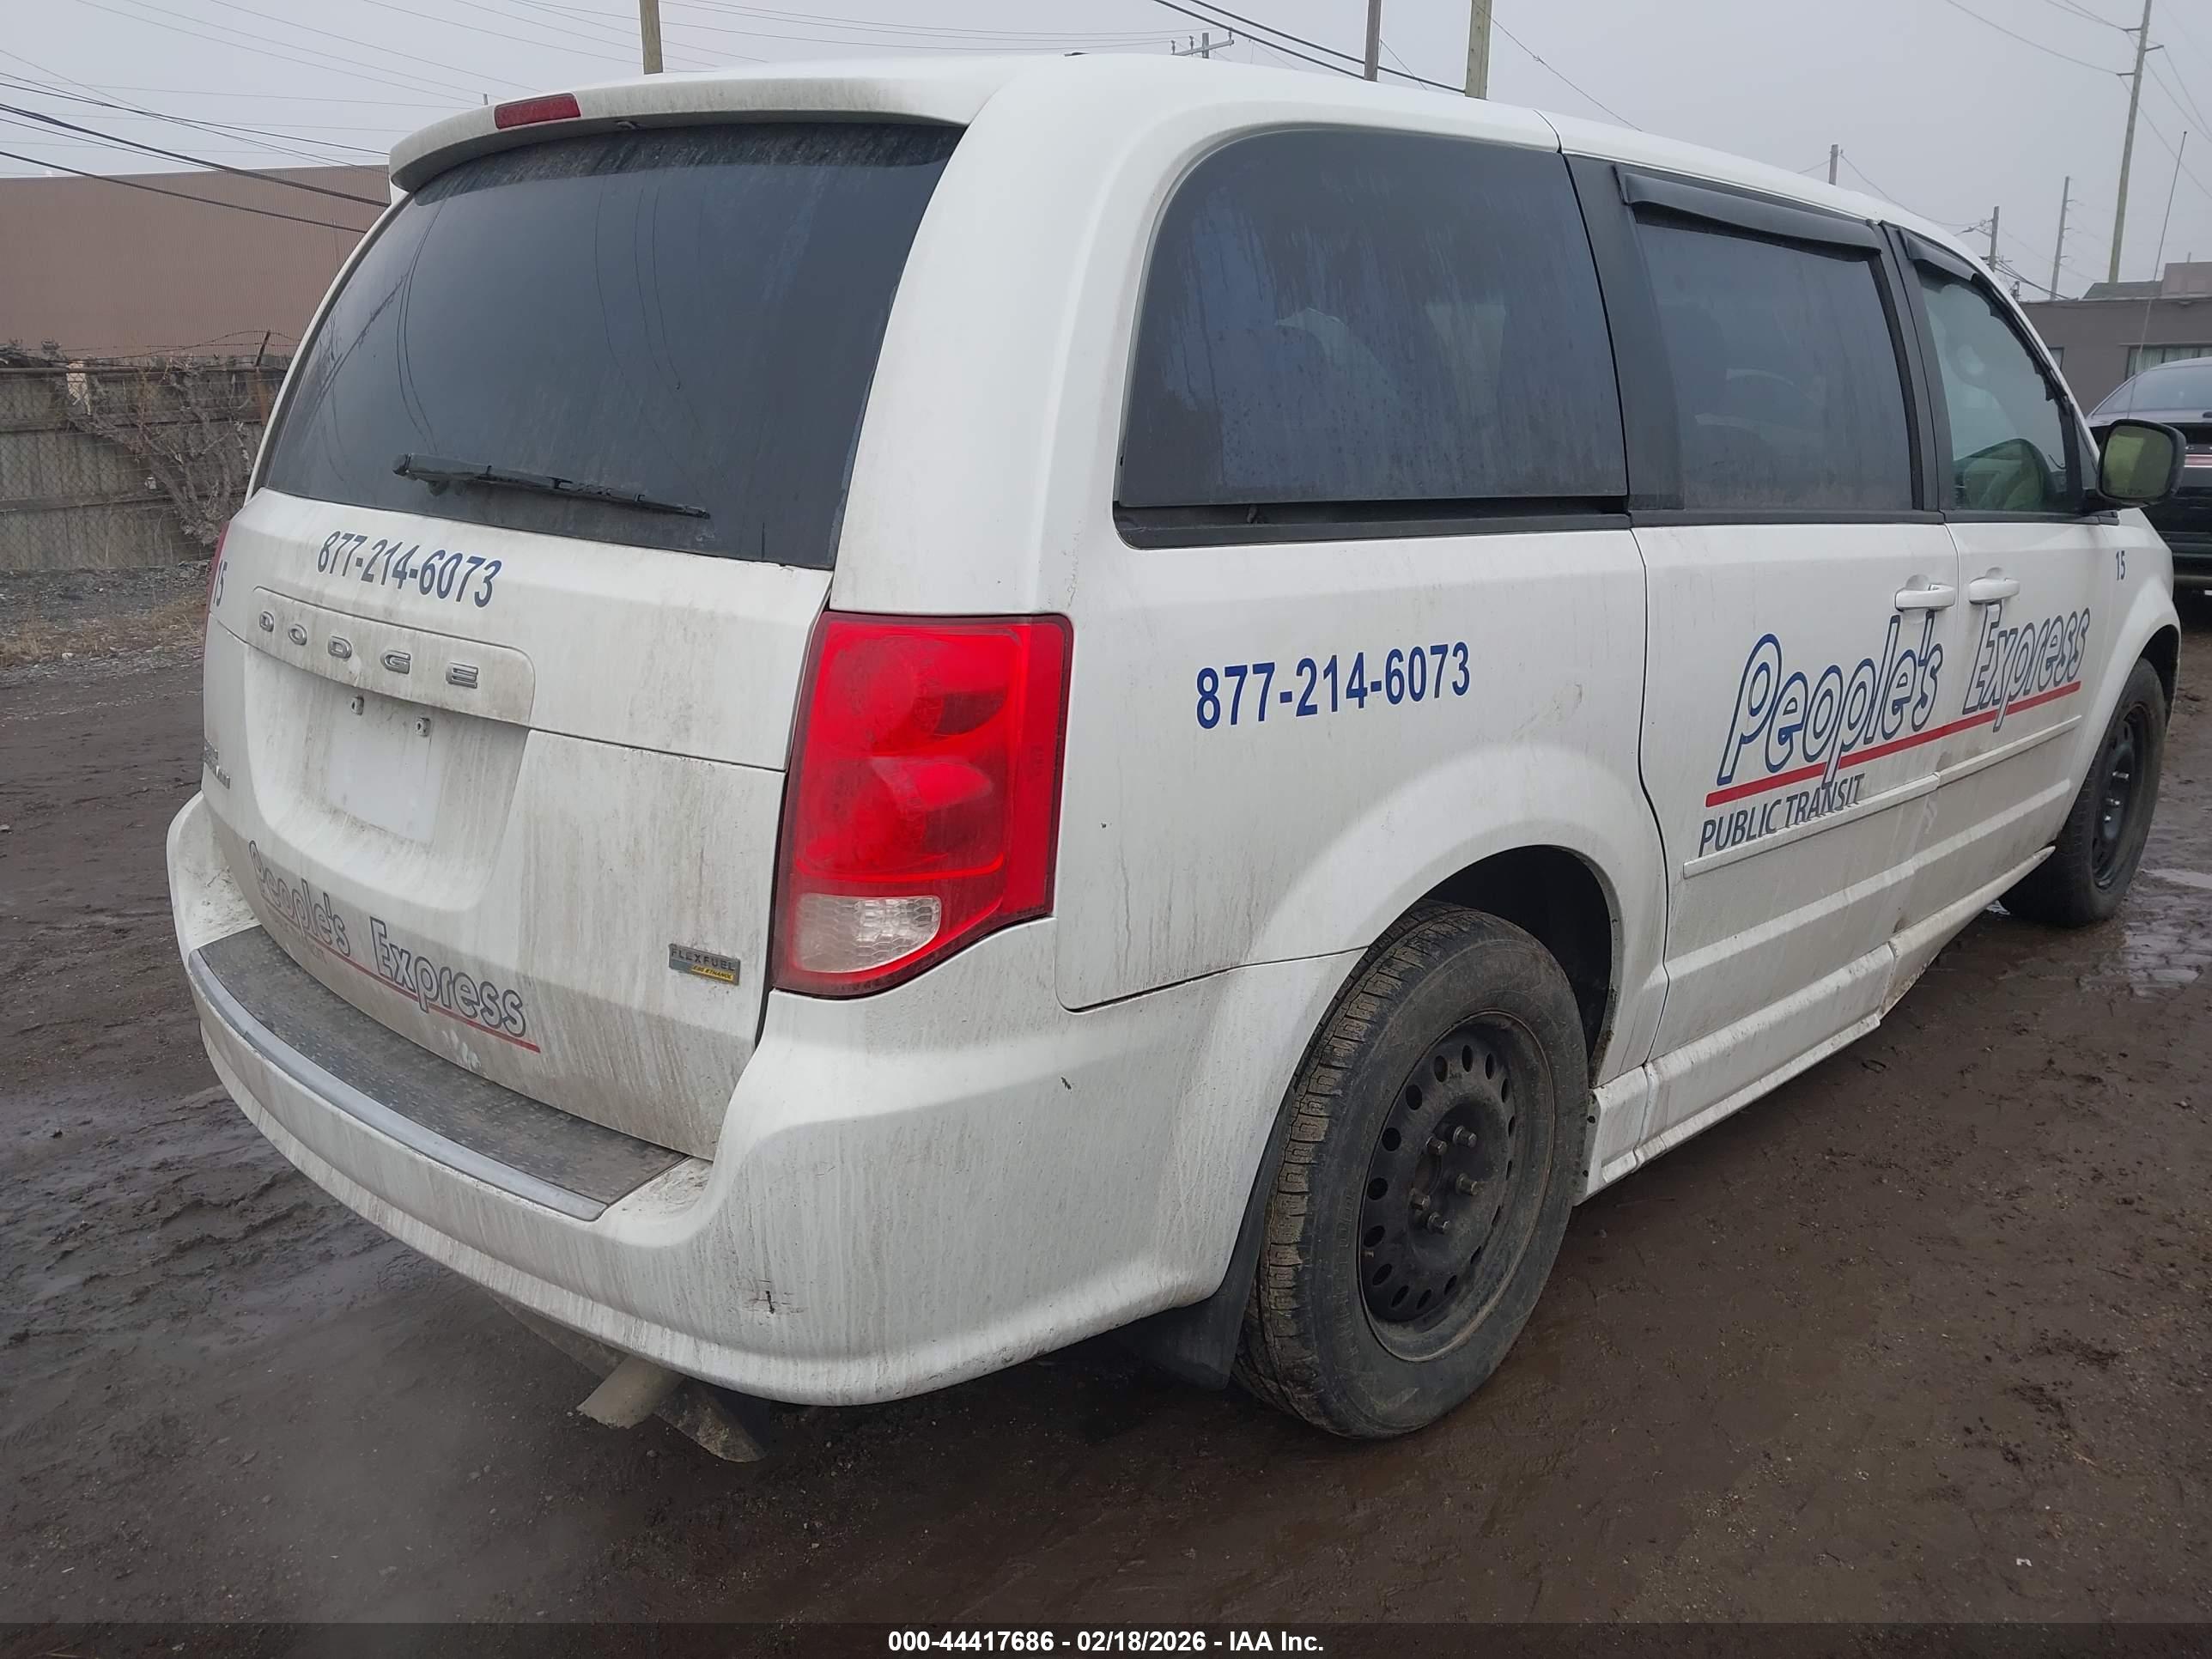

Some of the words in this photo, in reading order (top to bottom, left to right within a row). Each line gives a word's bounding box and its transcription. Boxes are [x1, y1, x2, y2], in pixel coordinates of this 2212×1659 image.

[318, 531, 502, 608] 877-214-6073
[2116, 550, 2125, 581] 15
[258, 611, 478, 688] DODGE
[1197, 641, 1470, 729] 877-214-6073
[1717, 611, 1944, 789] People's
[1963, 603, 2090, 732] Express
[1698, 799, 1781, 857] PUBLIC
[1785, 773, 1864, 828] TRANSIT
[370, 916, 526, 1037] Express
